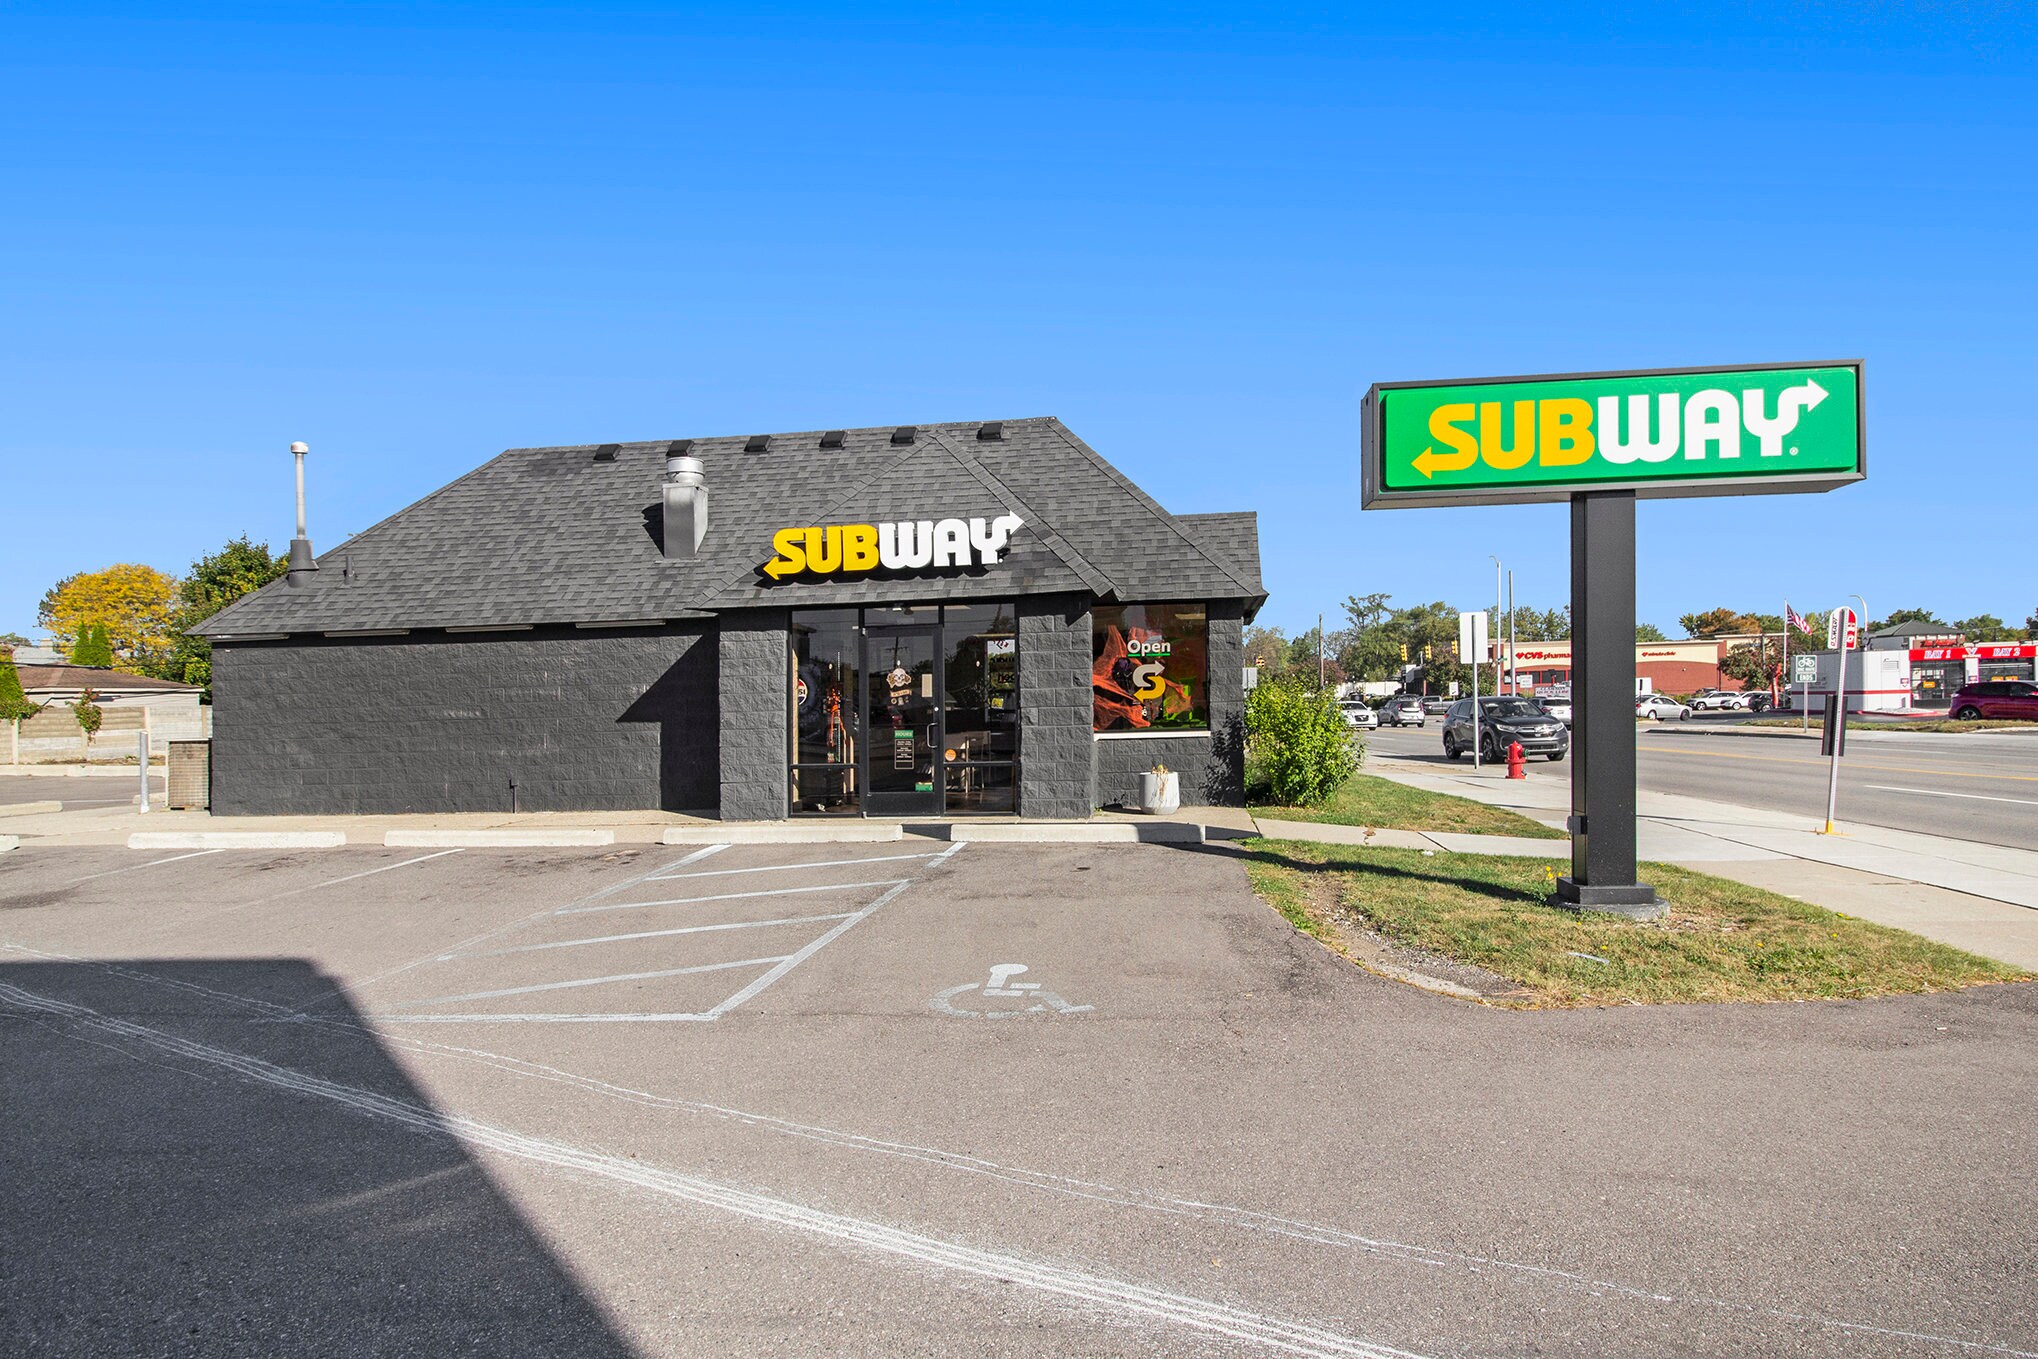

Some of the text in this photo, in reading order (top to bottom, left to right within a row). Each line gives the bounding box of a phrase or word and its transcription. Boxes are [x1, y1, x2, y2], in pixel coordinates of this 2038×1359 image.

[1411, 378, 1829, 479] SUBWAY
[763, 510, 1025, 580] SUBWAY
[1127, 639, 1171, 657] Open
[1524, 651, 1571, 660] CVS pharma
